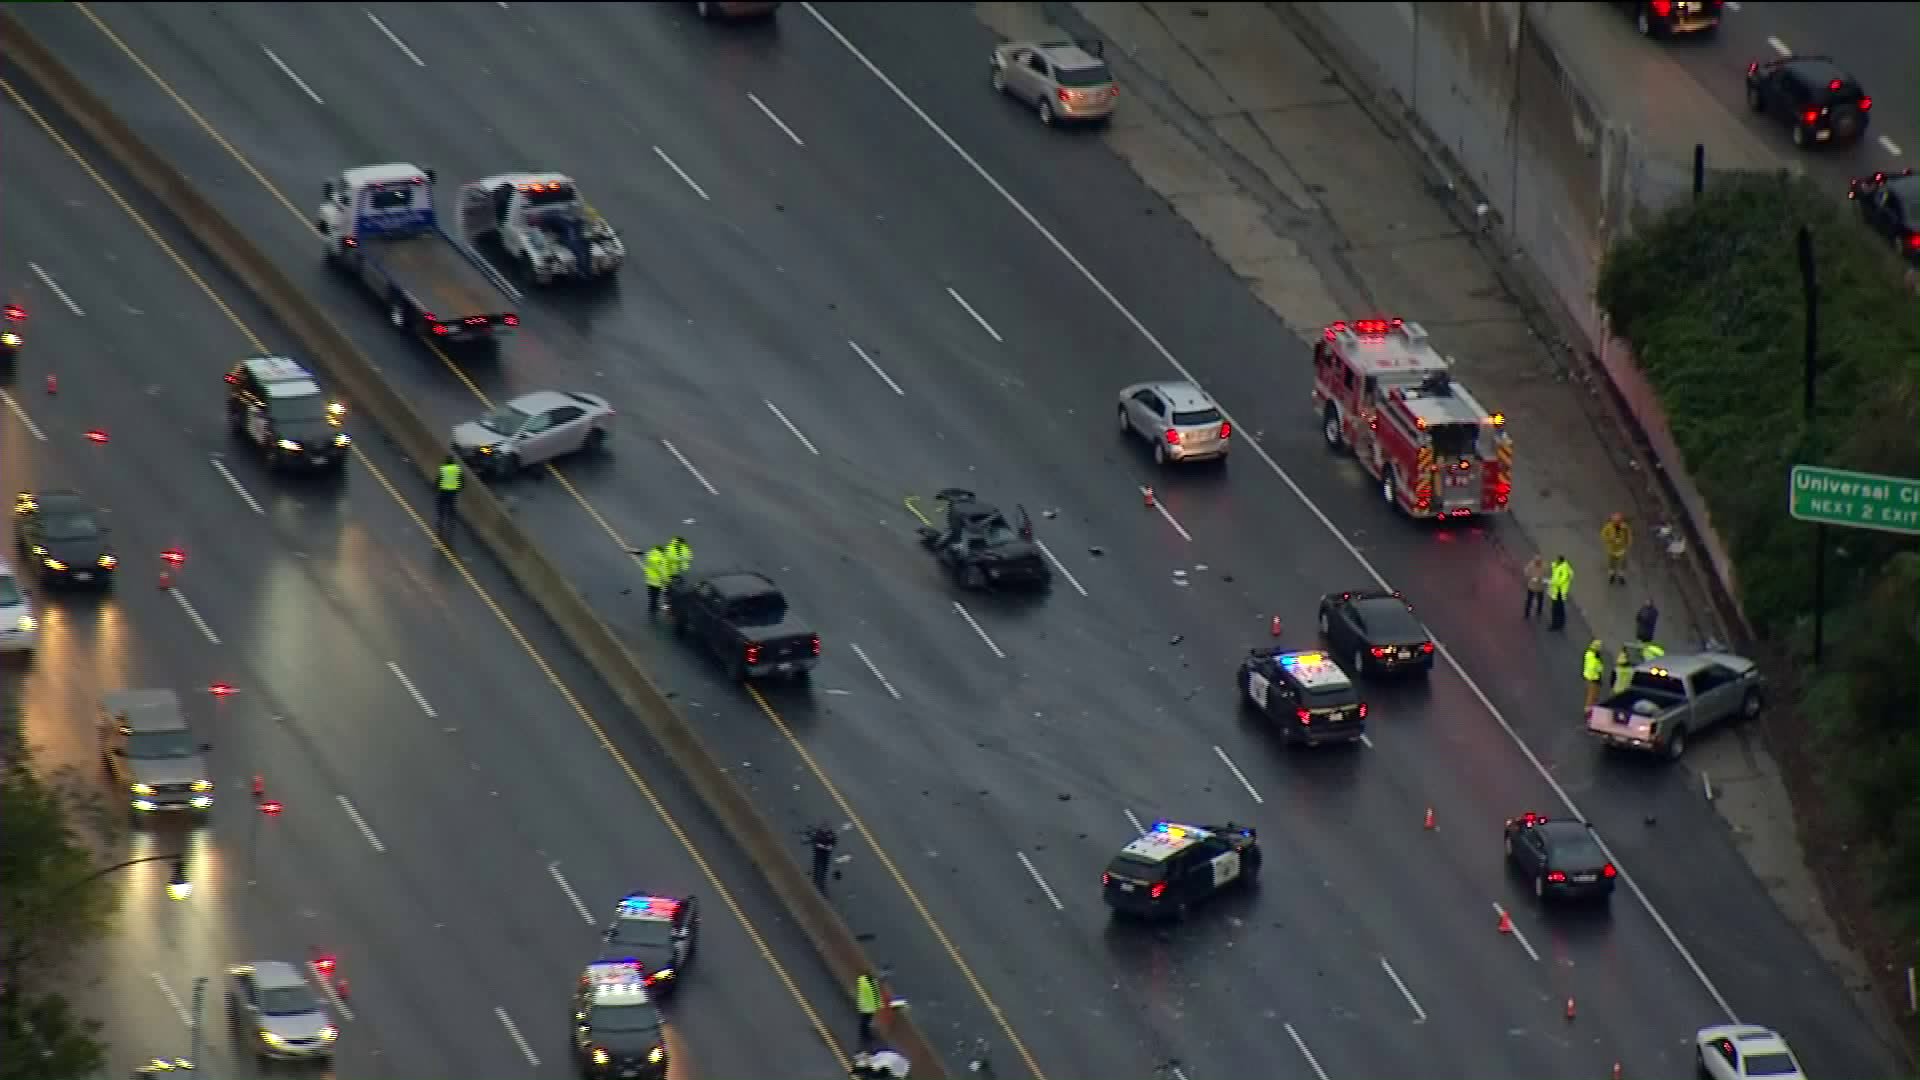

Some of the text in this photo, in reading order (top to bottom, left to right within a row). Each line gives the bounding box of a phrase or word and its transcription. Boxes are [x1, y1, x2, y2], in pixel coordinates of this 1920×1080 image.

[1796, 472, 1890, 499] Universal
[1811, 497, 1919, 524] NEXT 2 EXIT
